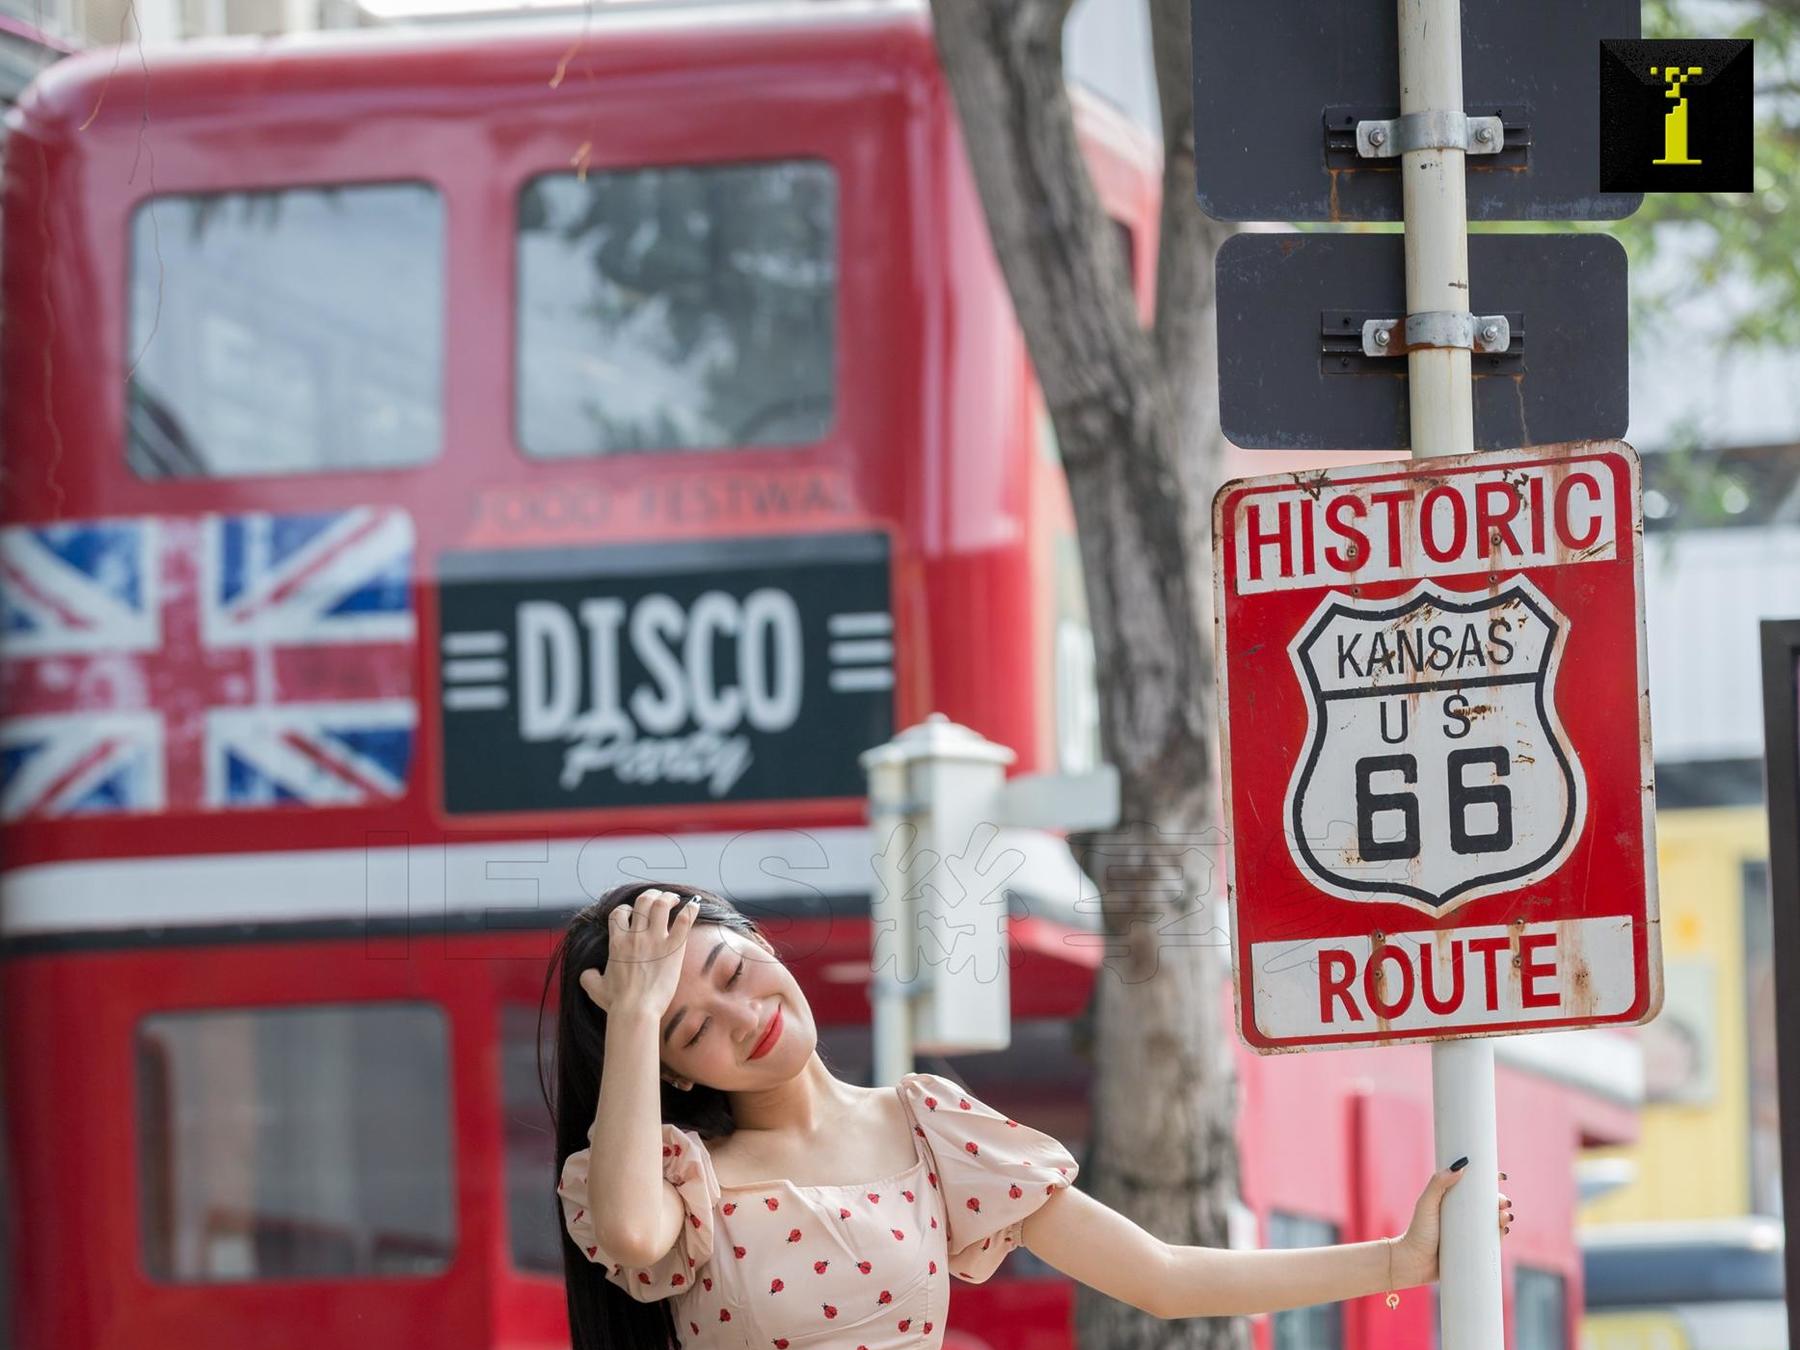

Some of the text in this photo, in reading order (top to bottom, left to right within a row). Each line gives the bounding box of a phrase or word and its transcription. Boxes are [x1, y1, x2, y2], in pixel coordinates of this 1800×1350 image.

[1245, 472, 1603, 581] HISTORIC
[516, 587, 803, 742] DISCO
[1337, 617, 1514, 679] KANSAS
[559, 710, 756, 799] Party
[1379, 693, 1471, 744] U S
[1355, 746, 1514, 863] 66
[1318, 932, 1562, 1023] ROUTE
